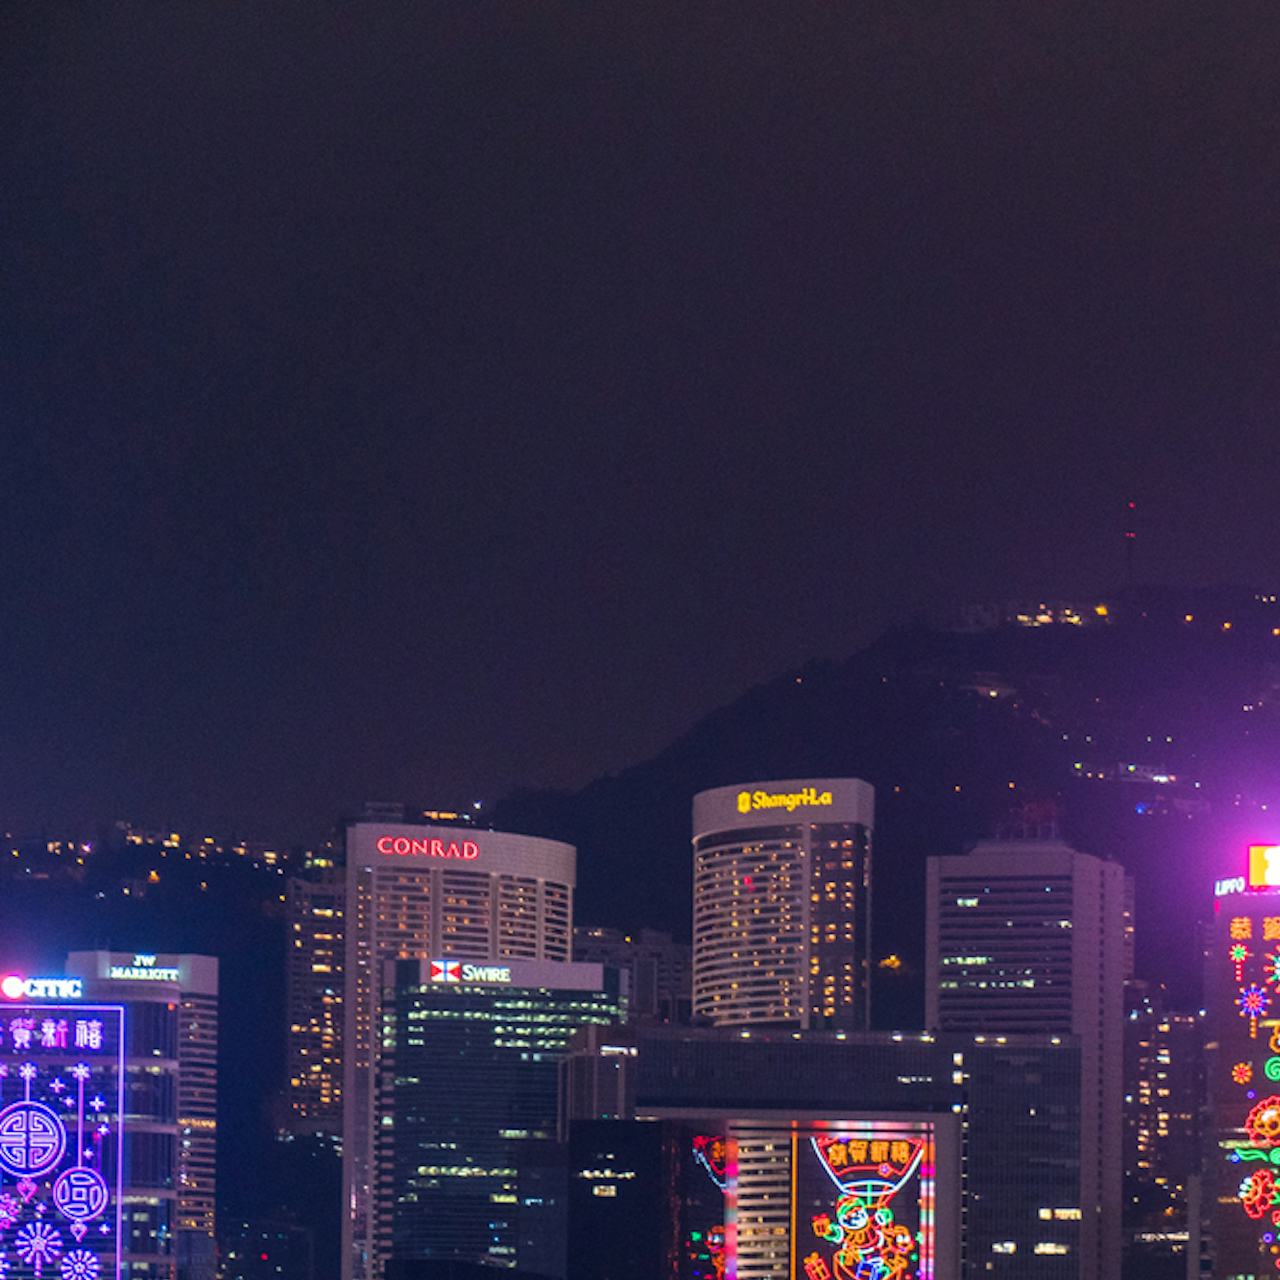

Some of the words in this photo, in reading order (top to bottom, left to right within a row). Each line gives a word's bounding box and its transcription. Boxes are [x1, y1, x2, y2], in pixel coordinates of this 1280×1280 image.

[377, 837, 479, 860] CONRAD
[1214, 877, 1246, 897] LIPPO
[133, 954, 157, 967] JW
[111, 966, 179, 981] MARRIOTT
[25, 978, 82, 998] CITIC
[0, 1018, 104, 1049] 賀新禧
